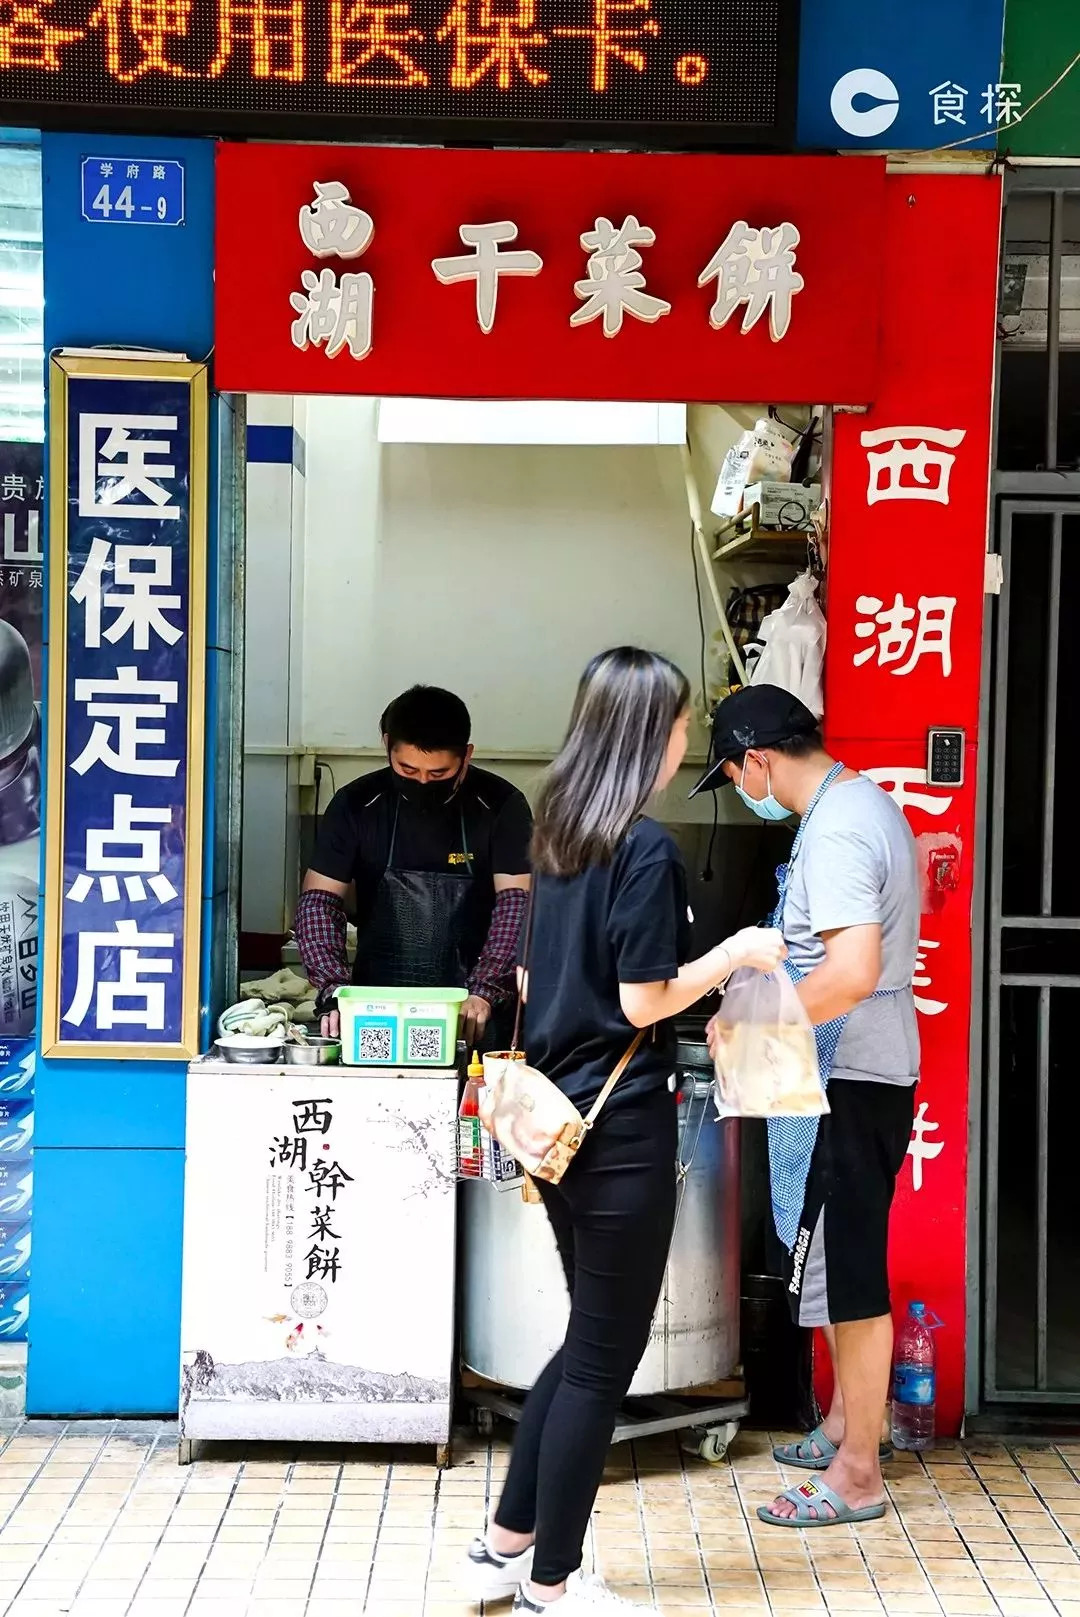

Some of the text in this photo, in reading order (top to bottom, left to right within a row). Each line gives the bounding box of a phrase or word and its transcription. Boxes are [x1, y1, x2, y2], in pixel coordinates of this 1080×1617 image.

[100, 162, 166, 180] 学府路
[92, 184, 167, 220] 44-9
[289, 181, 375, 361] 西湖
[4, 509, 44, 561] 山
[0, 569, 43, 588] 矿泉
[62, 412, 185, 1031] 医保定点店
